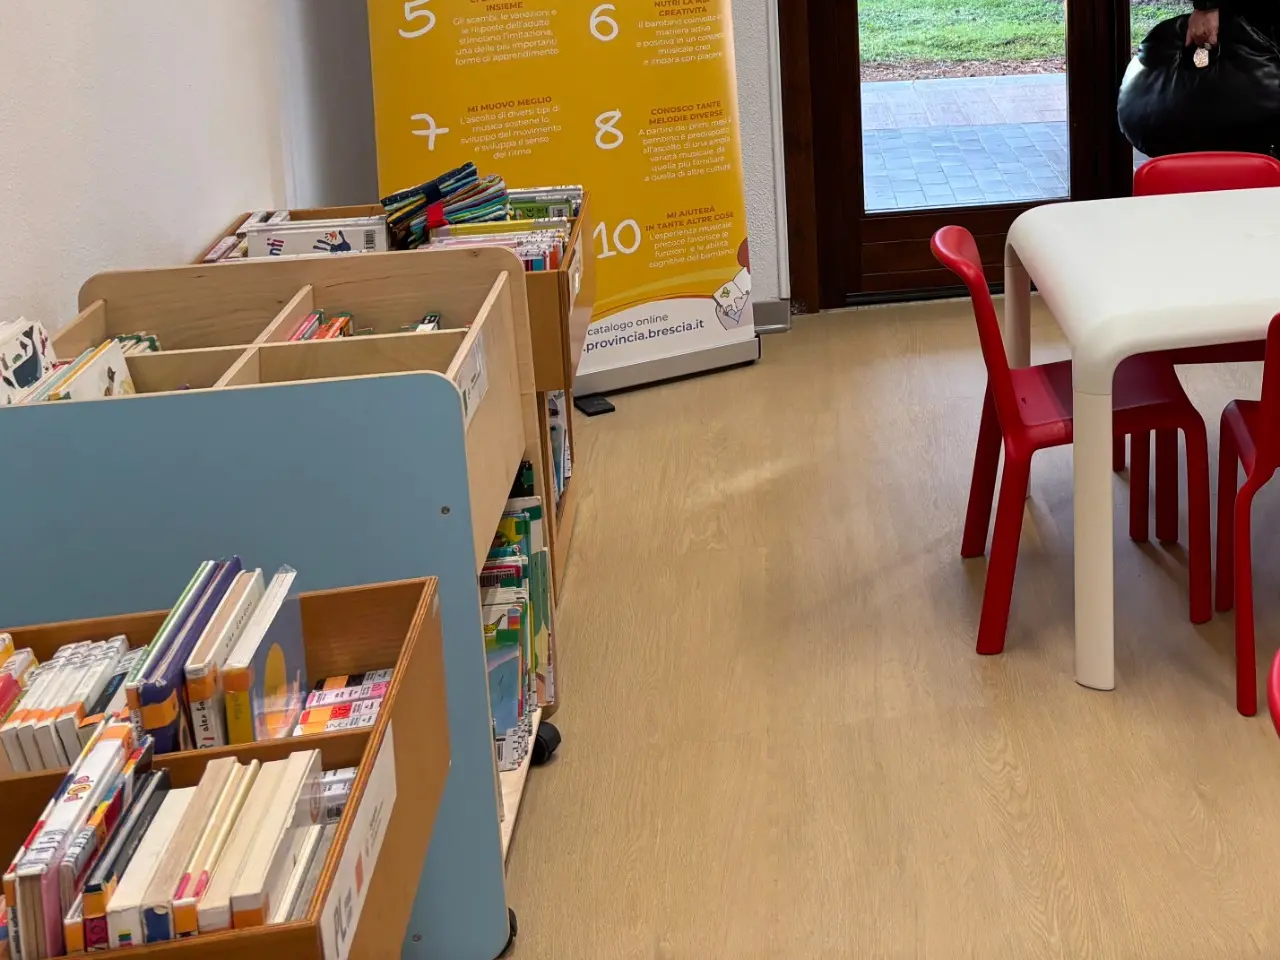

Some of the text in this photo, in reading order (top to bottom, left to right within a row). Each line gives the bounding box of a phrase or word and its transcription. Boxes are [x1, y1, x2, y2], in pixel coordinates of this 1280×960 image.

[486, 1, 523, 11] INSIEME
[655, 0, 680, 7] NUTRI
[590, 4, 618, 41] 6
[481, 100, 515, 111] MUOVO
[517, 96, 552, 107] MEGLIO
[651, 100, 721, 115] CONOSCO TANTE
[649, 110, 723, 125] MELODIE DIVERSE
[411, 113, 449, 151] 7
[595, 108, 623, 150] 8
[656, 220, 685, 230] TANTE
[686, 216, 712, 227] ALTRE
[593, 218, 641, 259] 10
[587, 313, 669, 337] catalogo online
